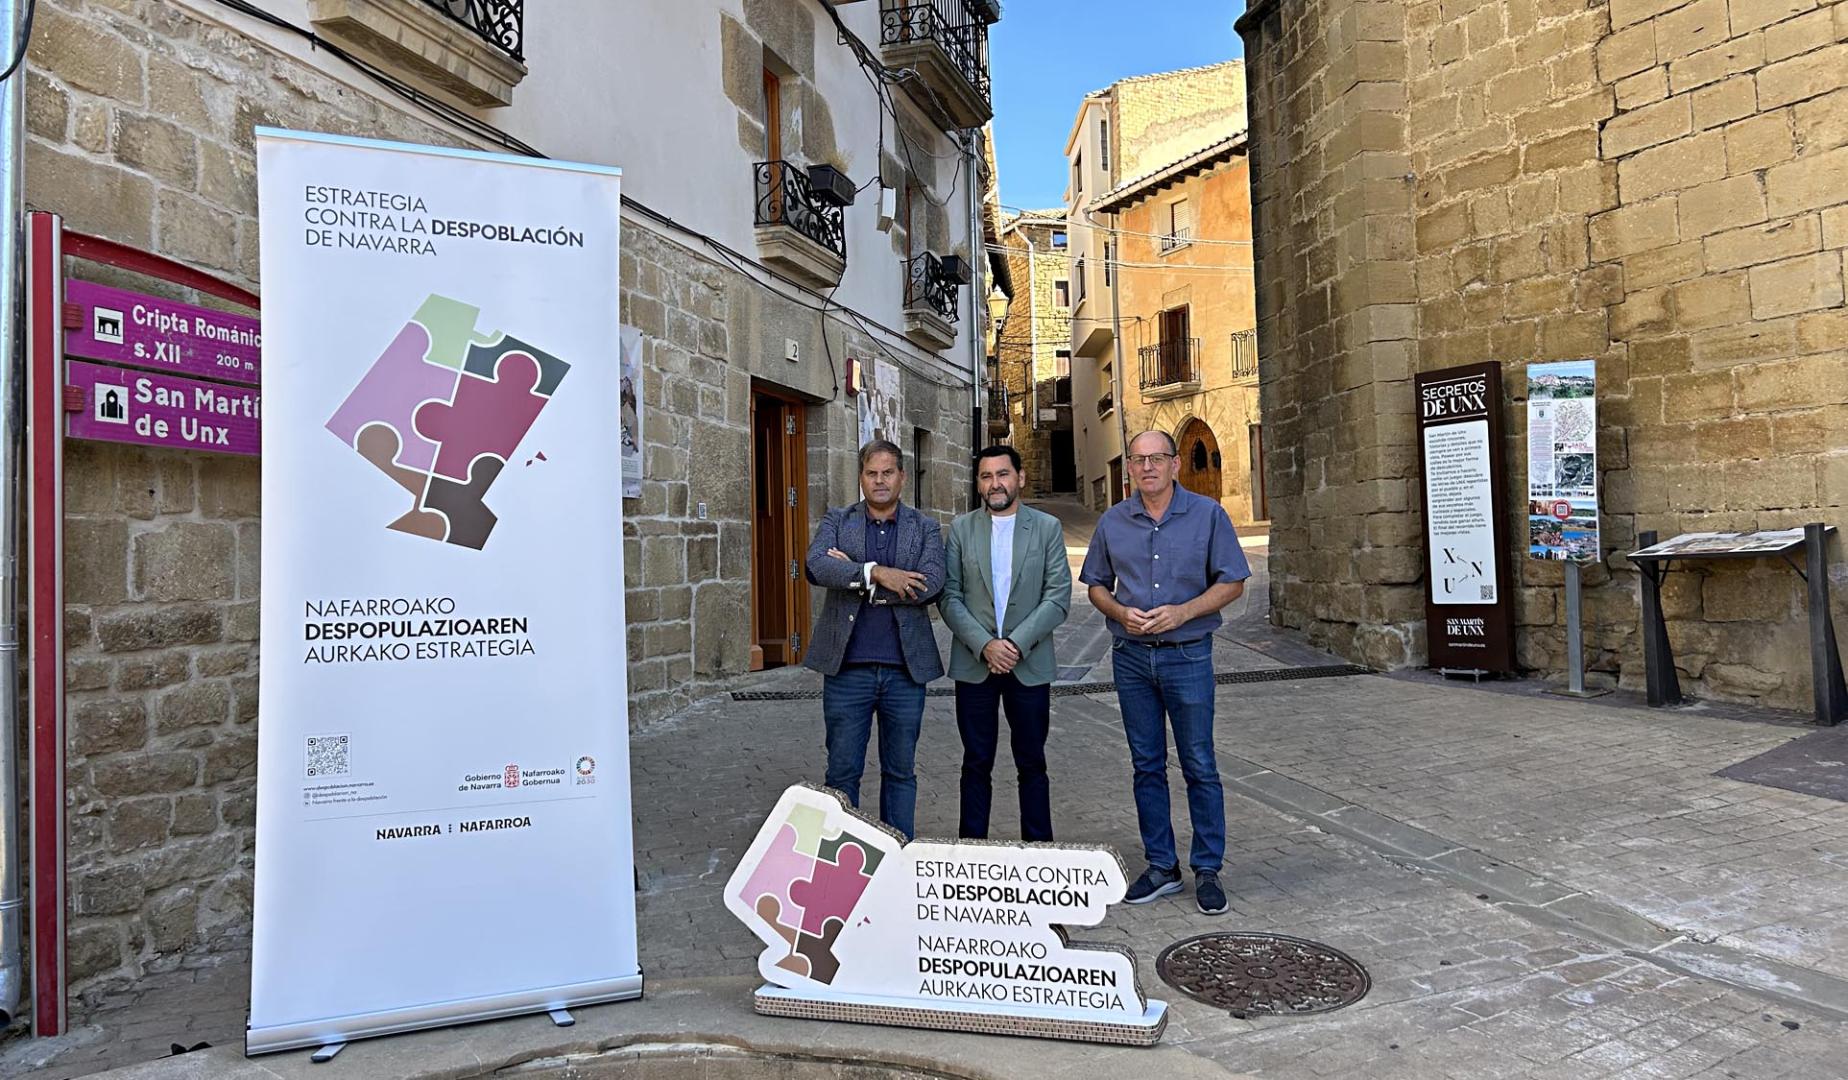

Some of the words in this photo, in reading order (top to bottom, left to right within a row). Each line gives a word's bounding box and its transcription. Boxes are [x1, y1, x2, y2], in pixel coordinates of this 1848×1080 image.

[306, 186, 428, 213] ESTRATEGIA
[305, 208, 396, 231] CONTRA
[402, 217, 426, 234] LA
[431, 219, 584, 247] DESPOBLACIÓN
[306, 229, 332, 246] DE
[339, 231, 437, 256] NAVARRA
[133, 304, 188, 333] Cripta
[195, 317, 261, 347] Románic
[217, 354, 239, 367] 200
[793, 344, 797, 357] 2
[135, 378, 184, 408] San
[195, 388, 260, 418] Martí
[1422, 381, 1486, 400] SECRETOS
[1424, 399, 1446, 417] DE
[1450, 393, 1486, 413] UNX
[135, 414, 168, 437] de
[181, 417, 229, 445] Unx
[1443, 548, 1456, 564] X
[1471, 561, 1482, 577] N
[1444, 578, 1455, 593] U
[306, 598, 456, 618] NAFARROAKO
[306, 618, 527, 640] DESPOPULAZIOAREN
[1448, 625, 1461, 635] DE
[1463, 625, 1484, 635] UNX
[304, 643, 410, 663] AURKAKO
[416, 639, 535, 659] ESTRATEGIA
[465, 773, 501, 781] Gobierno
[522, 769, 565, 777] Nafarroako
[522, 778, 560, 786] Gobernua
[376, 825, 441, 840] NAVARRA
[460, 817, 531, 832] NAFARROA
[916, 861, 1022, 881] ESTRATEGIA
[1026, 866, 1108, 886] CONTRA
[917, 883, 939, 899] LA
[943, 884, 1089, 907] DESPOBLACIÓN
[917, 904, 939, 920] DE
[945, 906, 1032, 926] NAVARRA
[919, 935, 1046, 959] NAFARROAKO
[919, 957, 1116, 987] DESPOPULAZIOAREN
[919, 979, 1007, 1000] AURKAKO
[1013, 986, 1125, 1010] ESTRATEGIA
